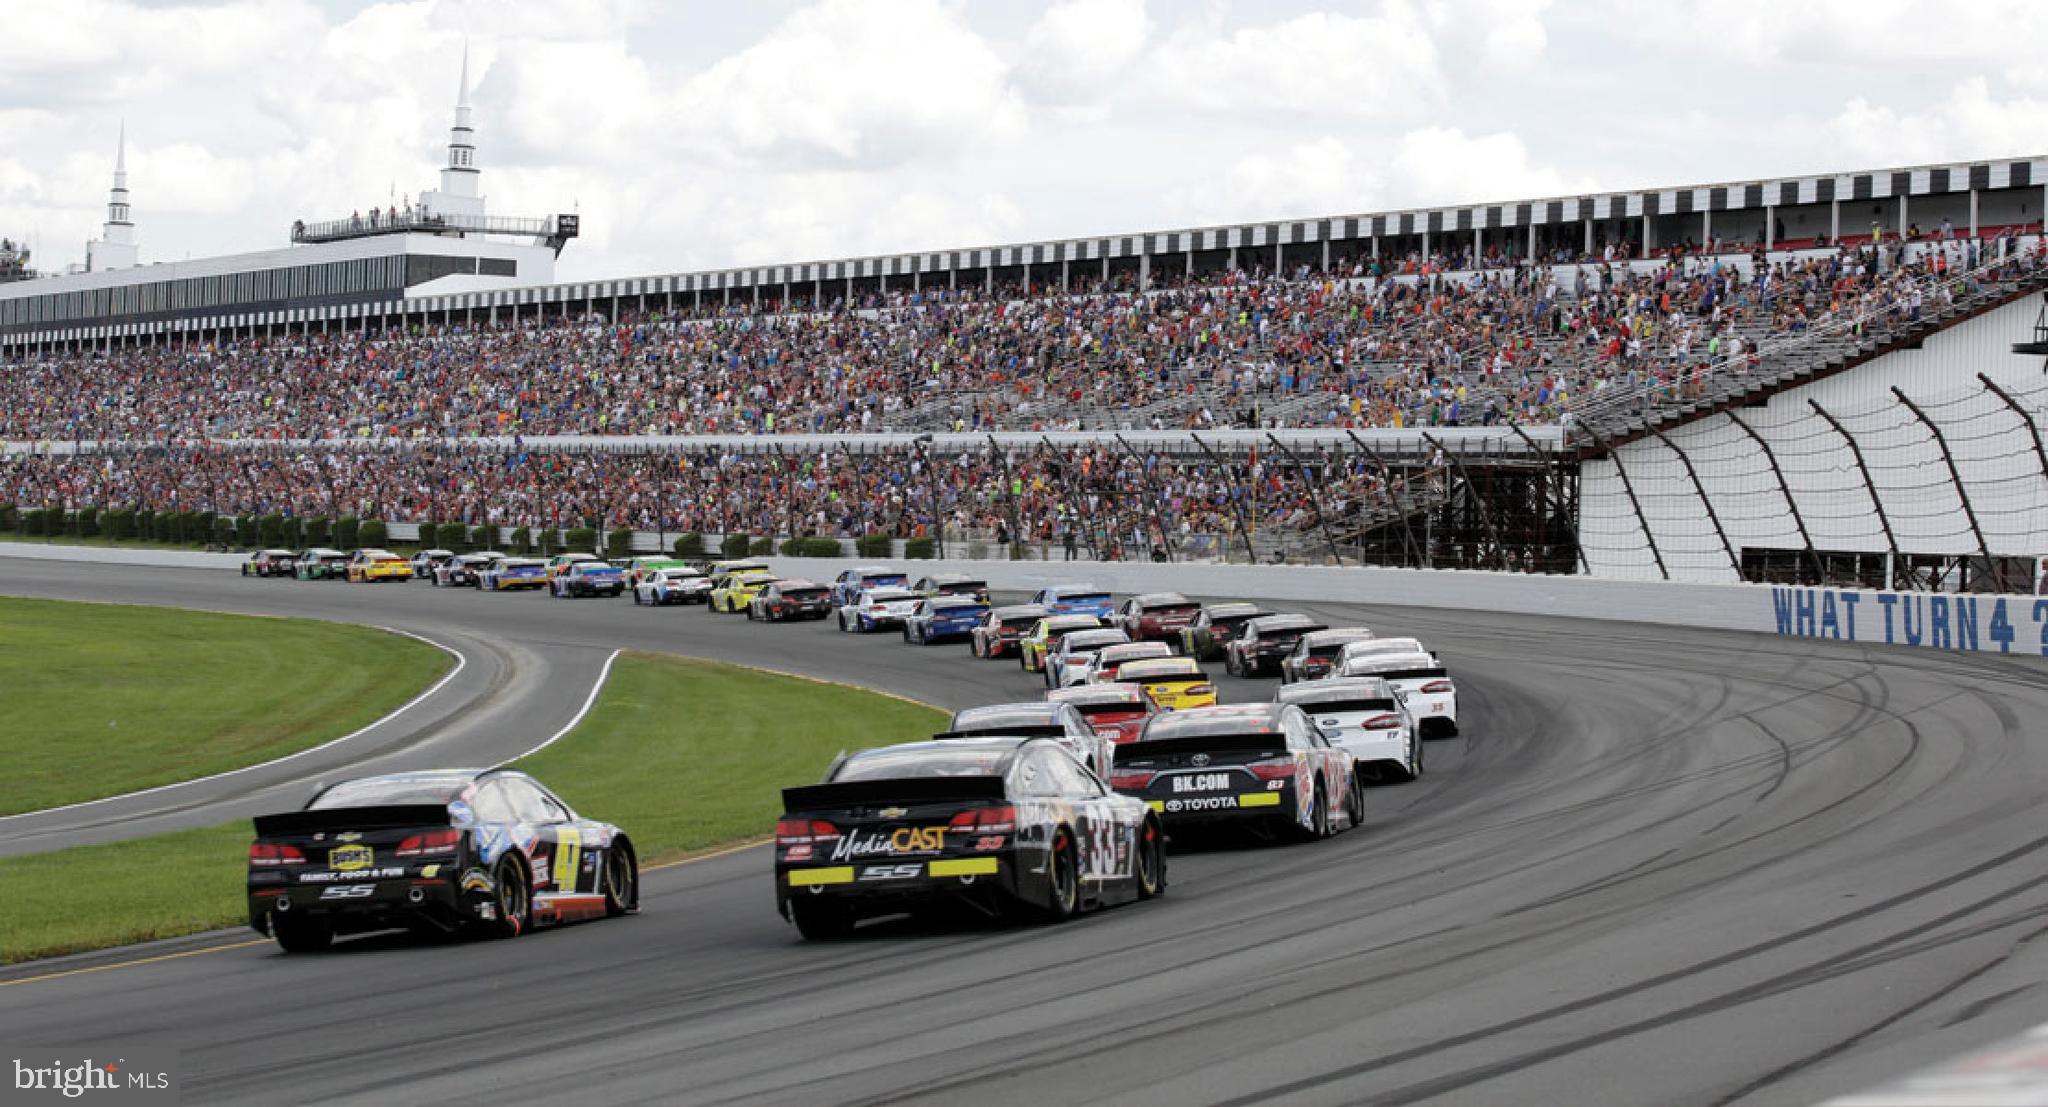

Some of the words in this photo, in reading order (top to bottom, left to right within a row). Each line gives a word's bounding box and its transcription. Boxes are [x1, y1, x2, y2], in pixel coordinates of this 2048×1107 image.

[1772, 588, 1860, 641] WHAT
[1877, 594, 1979, 652] TURN
[1989, 598, 2015, 654] 4
[1173, 773, 1230, 792] BK.COM
[1183, 796, 1238, 811] TOYOTA
[858, 863, 923, 881] SS
[319, 884, 377, 900] SS
